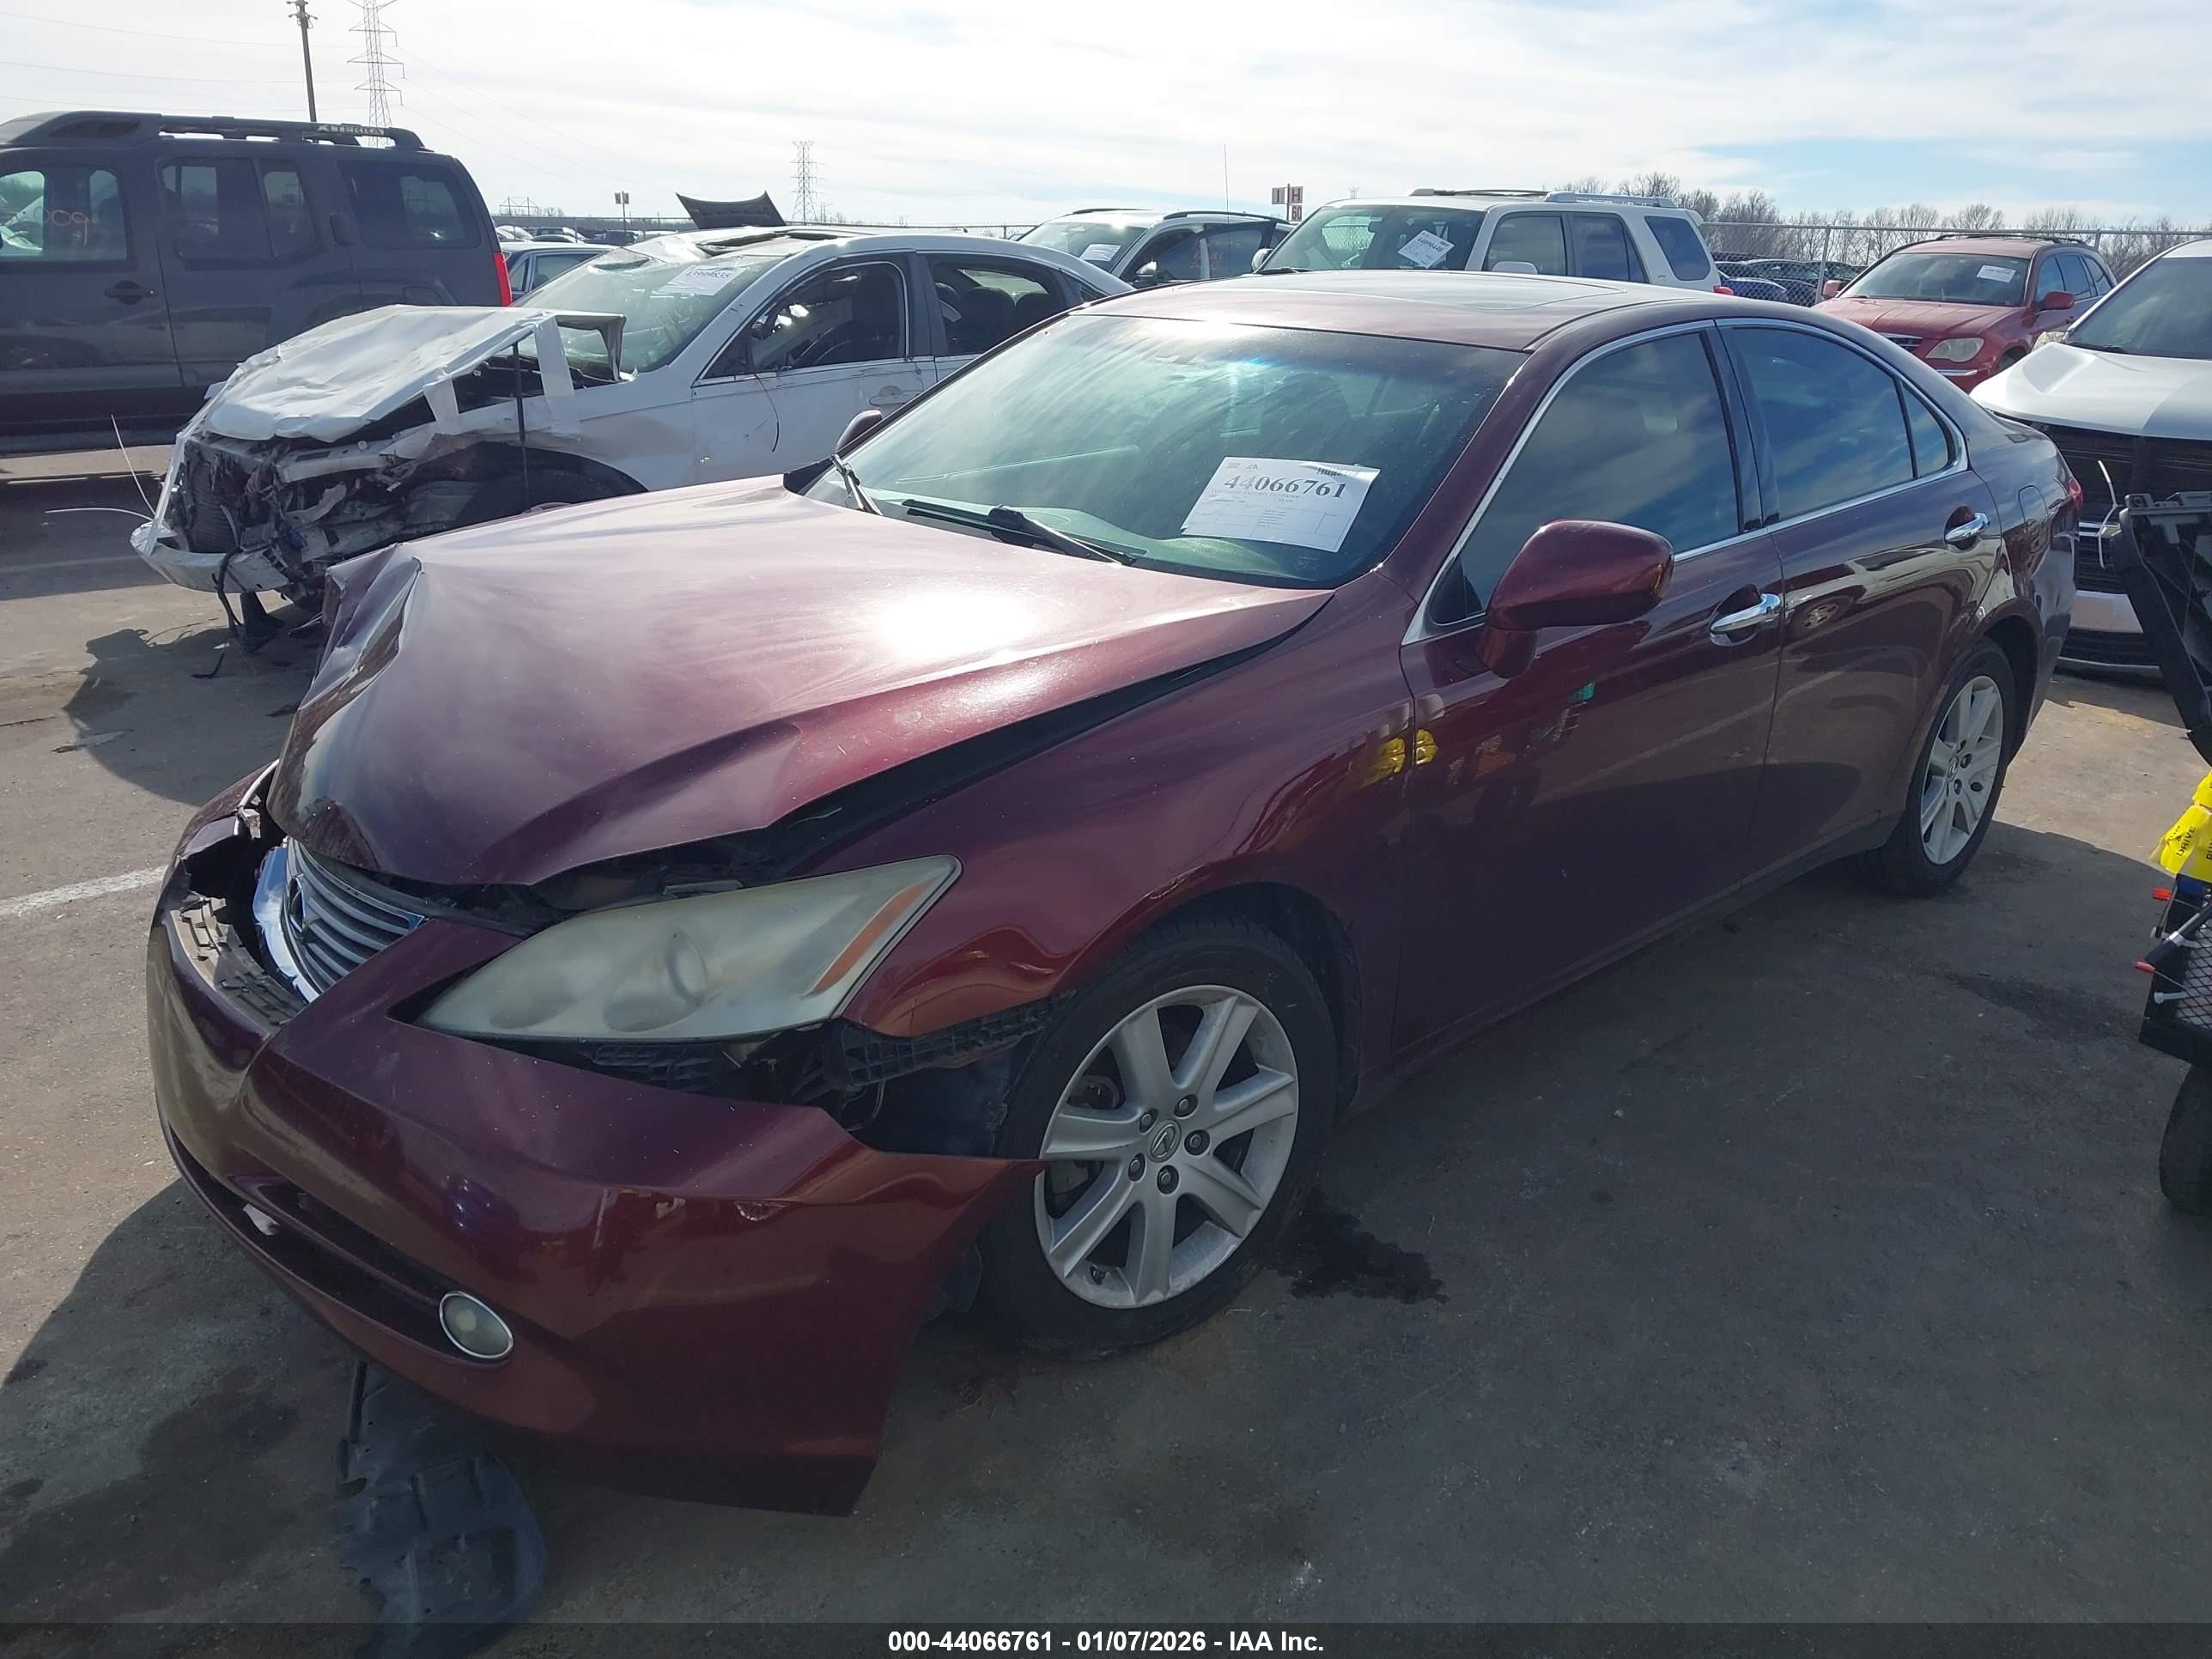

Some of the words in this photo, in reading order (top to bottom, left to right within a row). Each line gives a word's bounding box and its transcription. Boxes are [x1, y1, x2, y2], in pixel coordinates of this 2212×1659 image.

[1291, 205, 1303, 221] 60
[1224, 474, 1347, 499] 44066761
[2176, 826, 2197, 857] DRIVE
